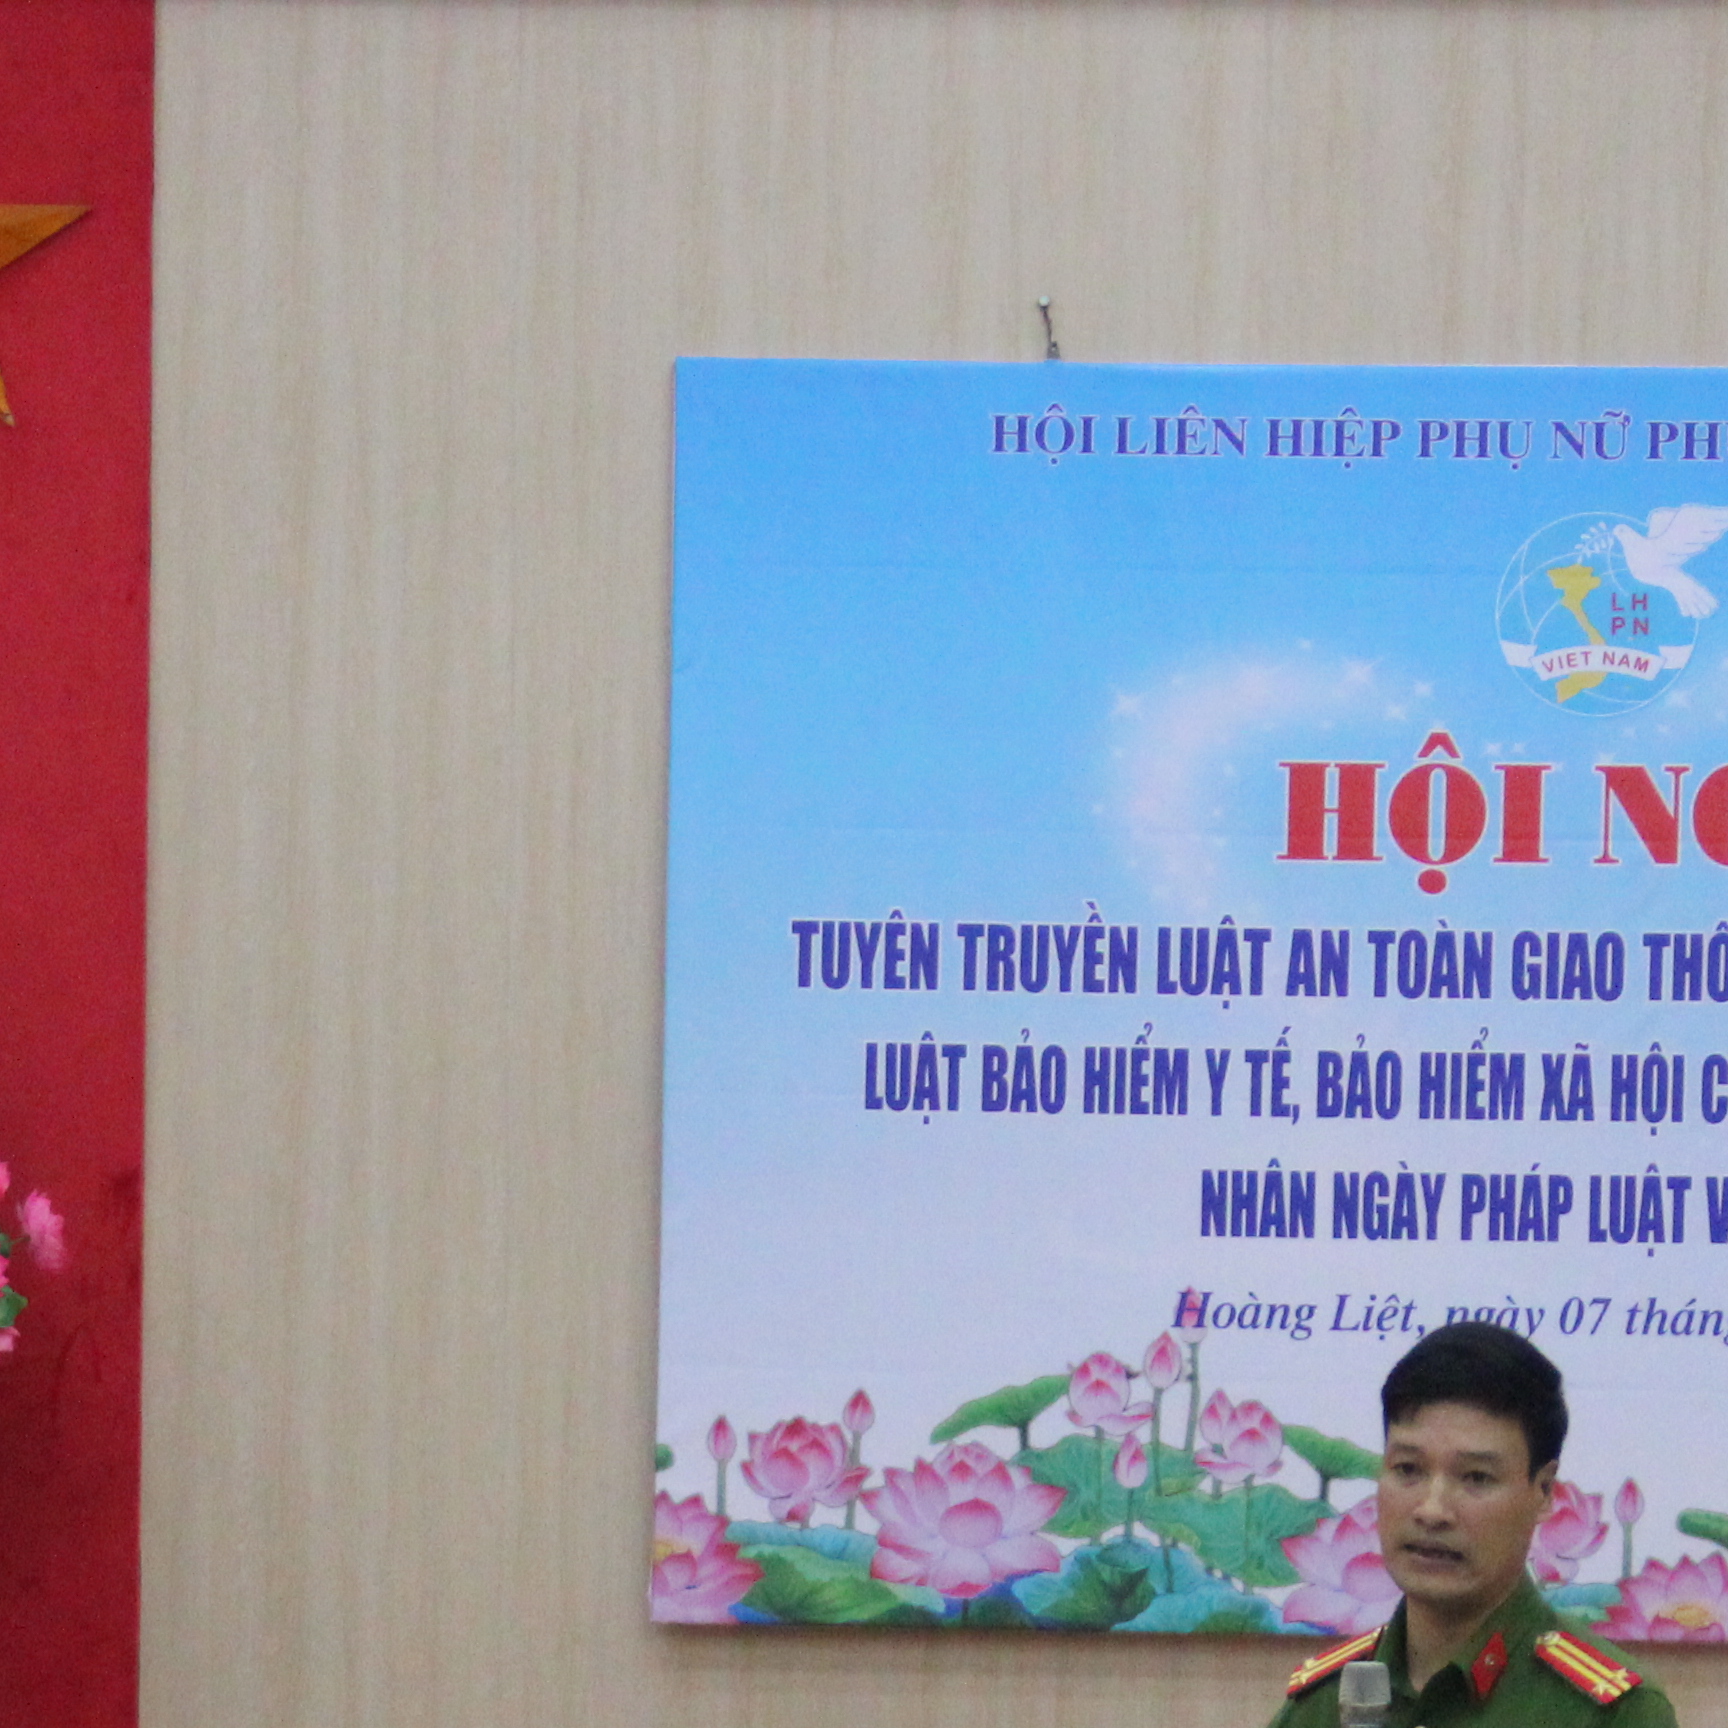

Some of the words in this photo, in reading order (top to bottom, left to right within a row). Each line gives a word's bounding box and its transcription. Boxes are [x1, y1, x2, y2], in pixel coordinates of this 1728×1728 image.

[992, 404, 1095, 464] HỘI
[1115, 406, 1247, 455] LIÊN
[1266, 408, 1401, 468] HIỆP
[1418, 421, 1532, 469] PHỤ
[1552, 411, 1630, 460] NỮ
[1541, 651, 1592, 673] VIET
[1603, 651, 1650, 673] NAM
[1276, 729, 1551, 894] HỘI
[792, 910, 939, 990] TUYÊN
[957, 900, 1138, 994] TRUYỀN
[1157, 915, 1271, 1009] LUẬT
[1285, 929, 1349, 997] AN
[1368, 920, 1493, 999] TOÀN
[1512, 931, 1625, 1001] GIAO
[865, 1031, 966, 1124] LUẬT
[982, 1027, 1066, 1114] BẢO
[1084, 1021, 1189, 1115] HIỂM
[1205, 1049, 1231, 1116] Y
[1245, 1025, 1301, 1126] TẾ,
[1317, 1033, 1402, 1120] BẢO
[1419, 1027, 1525, 1120] HIỂM
[1540, 1043, 1594, 1121] XÃ
[1610, 1042, 1684, 1136] HỘI
[1201, 1157, 1315, 1238] NHÂN
[1333, 1162, 1445, 1240] NGÀY
[1461, 1164, 1573, 1242] PHÁP
[1589, 1164, 1691, 1257] LUẬT
[1171, 1291, 1316, 1340] Hoàng
[1329, 1294, 1426, 1341] Liệt,
[1560, 1298, 1611, 1334] 07
